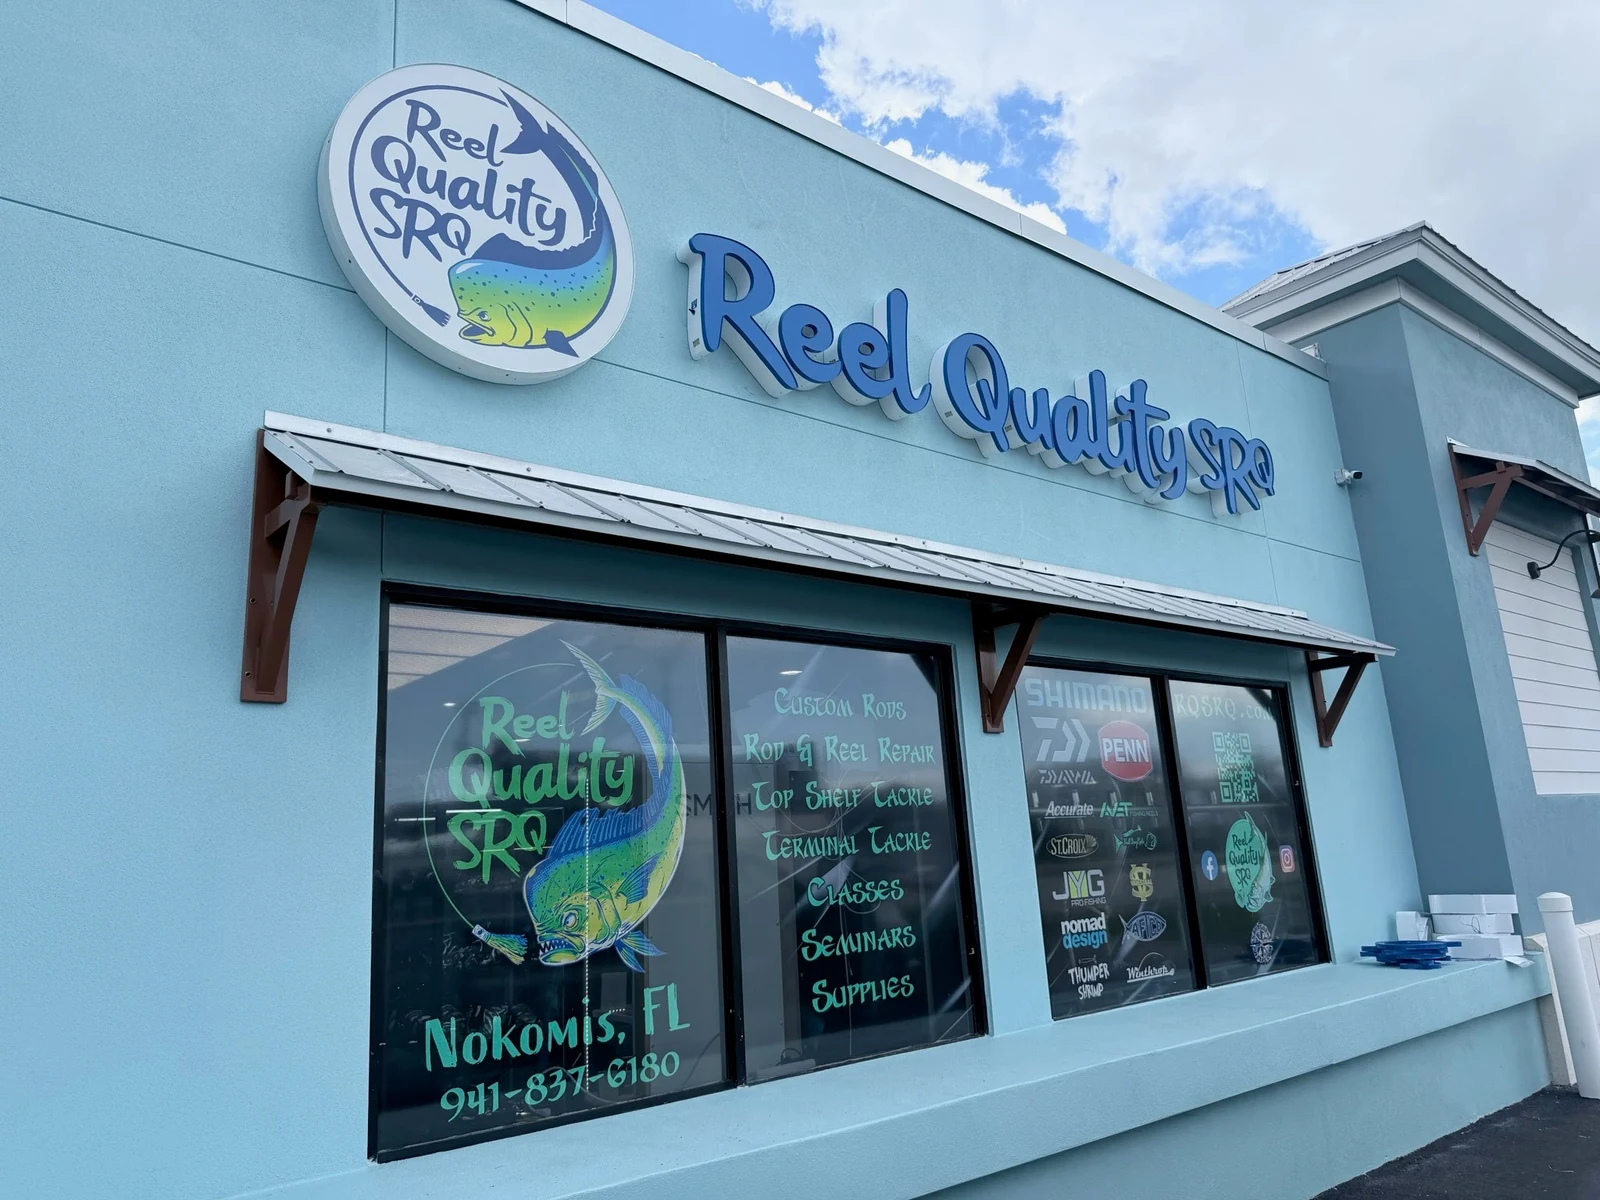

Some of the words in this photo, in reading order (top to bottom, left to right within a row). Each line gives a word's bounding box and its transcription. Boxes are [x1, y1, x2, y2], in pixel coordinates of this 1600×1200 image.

[406, 99, 503, 167] Reel
[371, 135, 567, 246] Quality
[369, 187, 471, 263] SRQ
[689, 232, 931, 414] Reel
[942, 332, 1187, 500] Quality
[1187, 417, 1275, 515] SRQ
[1024, 678, 1148, 714] SHIMANO
[479, 690, 575, 758] Reel
[1101, 737, 1150, 763] PENN
[448, 736, 635, 808] Quality
[1038, 769, 1096, 785] DAIWA
[1045, 801, 1094, 817] Accurate
[1100, 801, 1132, 818] AVET
[446, 811, 547, 884] SRQ
[1232, 832, 1248, 850] Reel
[1229, 849, 1259, 867] Quality
[1052, 869, 1105, 900] JYG
[1235, 867, 1251, 887] SRQ
[1061, 912, 1106, 935] nomad
[1062, 930, 1108, 949] design
[1068, 962, 1110, 985] THUMPER
[1127, 965, 1169, 980] Winthrop
[1077, 983, 1104, 1000] SHRIMP
[643, 982, 691, 1035] FL
[440, 1051, 680, 1122] 941-837-6180
